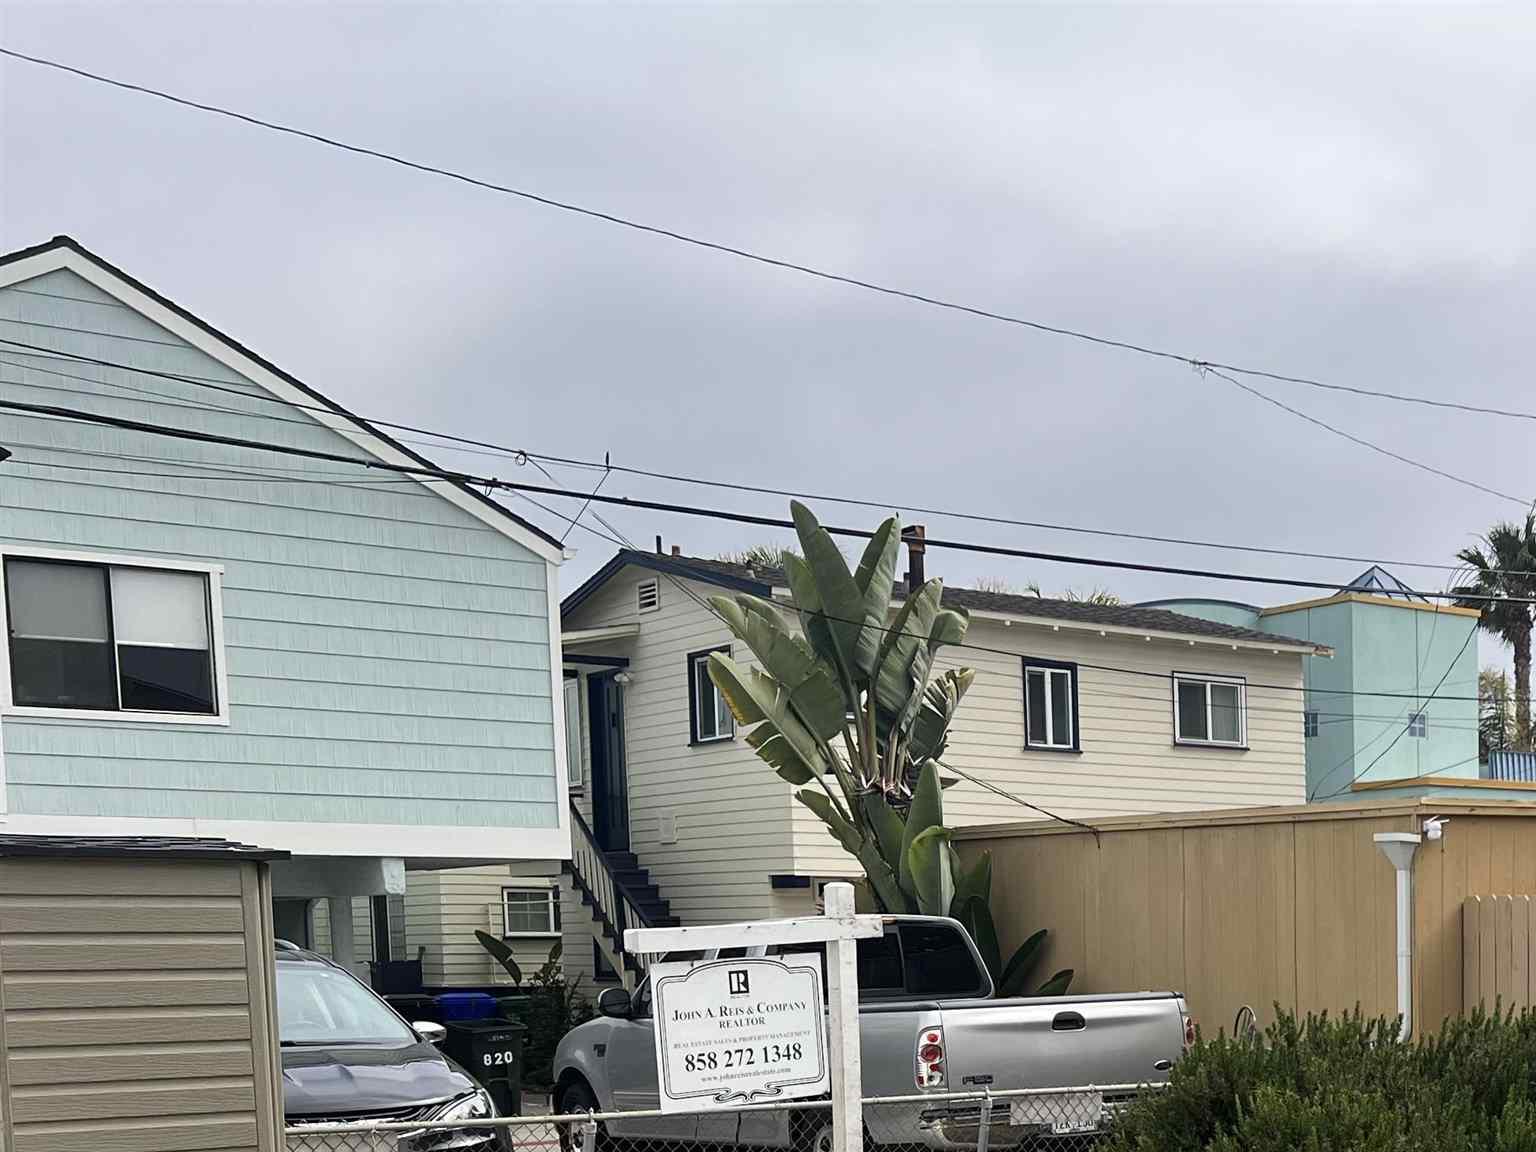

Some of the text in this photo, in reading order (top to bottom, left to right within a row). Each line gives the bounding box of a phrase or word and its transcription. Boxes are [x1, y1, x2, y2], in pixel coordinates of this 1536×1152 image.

[672, 1009, 701, 1021] JOHN
[719, 1005, 744, 1017] REIS
[745, 1008, 753, 1016] &
[756, 1001, 807, 1015] COMPANY
[719, 1016, 766, 1029] REALTOR
[483, 1051, 513, 1066] 820
[684, 1042, 803, 1072] 858 272 1348
